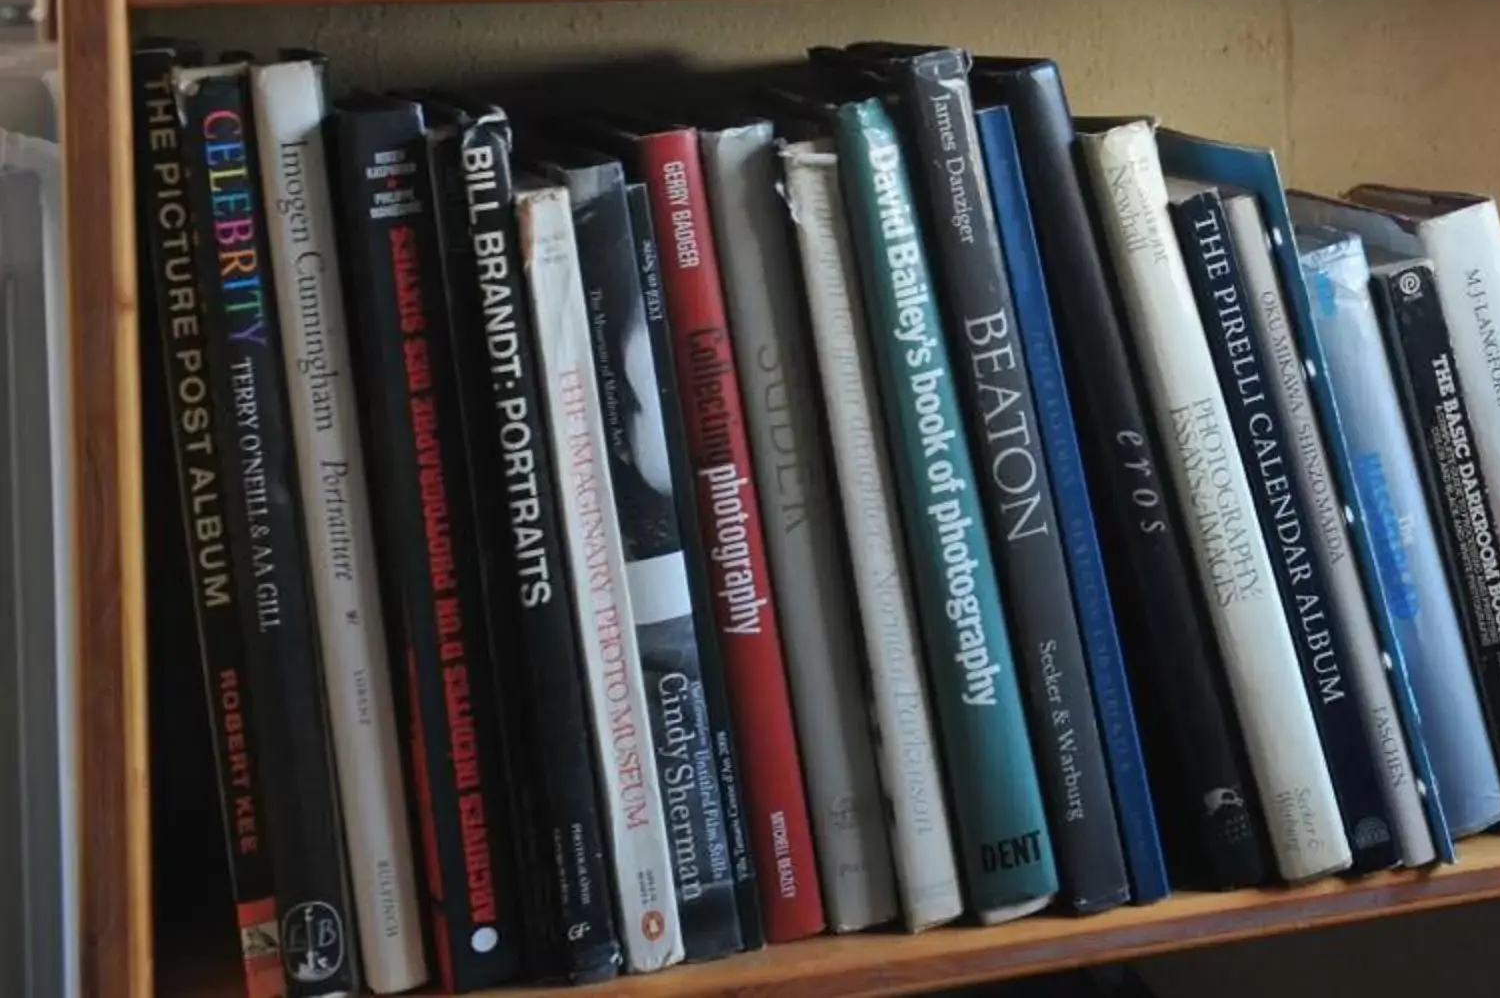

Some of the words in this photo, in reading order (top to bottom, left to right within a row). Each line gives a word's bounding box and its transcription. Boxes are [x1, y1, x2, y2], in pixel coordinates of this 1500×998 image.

[144, 75, 178, 151] THE
[460, 145, 494, 225] BILL
[662, 160, 691, 208] GERRY
[871, 128, 912, 239] David
[928, 92, 960, 150] James
[945, 154, 977, 245] Danziger
[1107, 164, 1152, 252] Newhall
[153, 161, 201, 340] PICTURE
[202, 109, 267, 348] CELEBRITY
[671, 210, 702, 269] BADGER
[1192, 208, 1233, 281] THE
[276, 140, 312, 244] Imogen
[296, 250, 341, 434] Cunningham
[388, 227, 430, 334] SIXTIES
[472, 230, 521, 392] BRANDT:
[589, 287, 603, 311] The
[815, 249, 846, 302] you
[890, 241, 940, 368] Bailey's
[403, 338, 433, 393] DES
[592, 313, 610, 359] Museum
[831, 305, 853, 341] let
[1211, 282, 1266, 408] PIRELLI
[176, 349, 214, 453] POST
[230, 356, 253, 431] TERRY
[556, 367, 586, 423] THE
[600, 361, 613, 377] of
[601, 379, 621, 429] Modern
[686, 326, 738, 465] Collecting
[832, 345, 864, 408] your
[911, 368, 957, 454] book
[1431, 353, 1456, 398] THE
[1445, 398, 1473, 460] BASIC
[964, 306, 1051, 542] BEATON
[1260, 289, 1284, 331] OKU
[1296, 422, 1330, 496] SHINZO
[1315, 497, 1346, 565] MAEDA
[237, 435, 264, 520] O'NEILL
[410, 398, 459, 591] PHOTOGRAPHE
[496, 398, 557, 610] PORTRAITS
[565, 434, 620, 597] IMAGINARY
[931, 458, 967, 492] of
[1116, 426, 1165, 536] eros
[1169, 403, 1210, 489] ESSAYS
[1194, 506, 1242, 609] IMAGES
[1191, 394, 1266, 604] PHOTOGRAPHY:
[1247, 410, 1316, 586] CALENDAR
[193, 466, 232, 608] ALBUM
[249, 523, 266, 540] &
[253, 546, 269, 580] AA
[318, 458, 353, 583] Portraiture
[696, 464, 769, 636] photography
[258, 582, 283, 634] GILL
[435, 602, 465, 662] D'UN
[926, 501, 1003, 708] photography
[1293, 590, 1346, 704] ALBUM
[656, 673, 702, 758] Cindy
[1038, 639, 1062, 705] Secker
[219, 667, 250, 788] ROBERT
[236, 795, 259, 854] KEE
[1054, 709, 1071, 729] &
[1372, 704, 1408, 789] TASCHEN
[695, 749, 721, 808] Untitled
[1056, 730, 1088, 823] Warburg
[459, 796, 497, 922] ARCHIVES
[662, 759, 707, 902] Sherman
[702, 808, 725, 841] Film
[709, 842, 731, 882] Stills
[978, 830, 1042, 876] DENT
